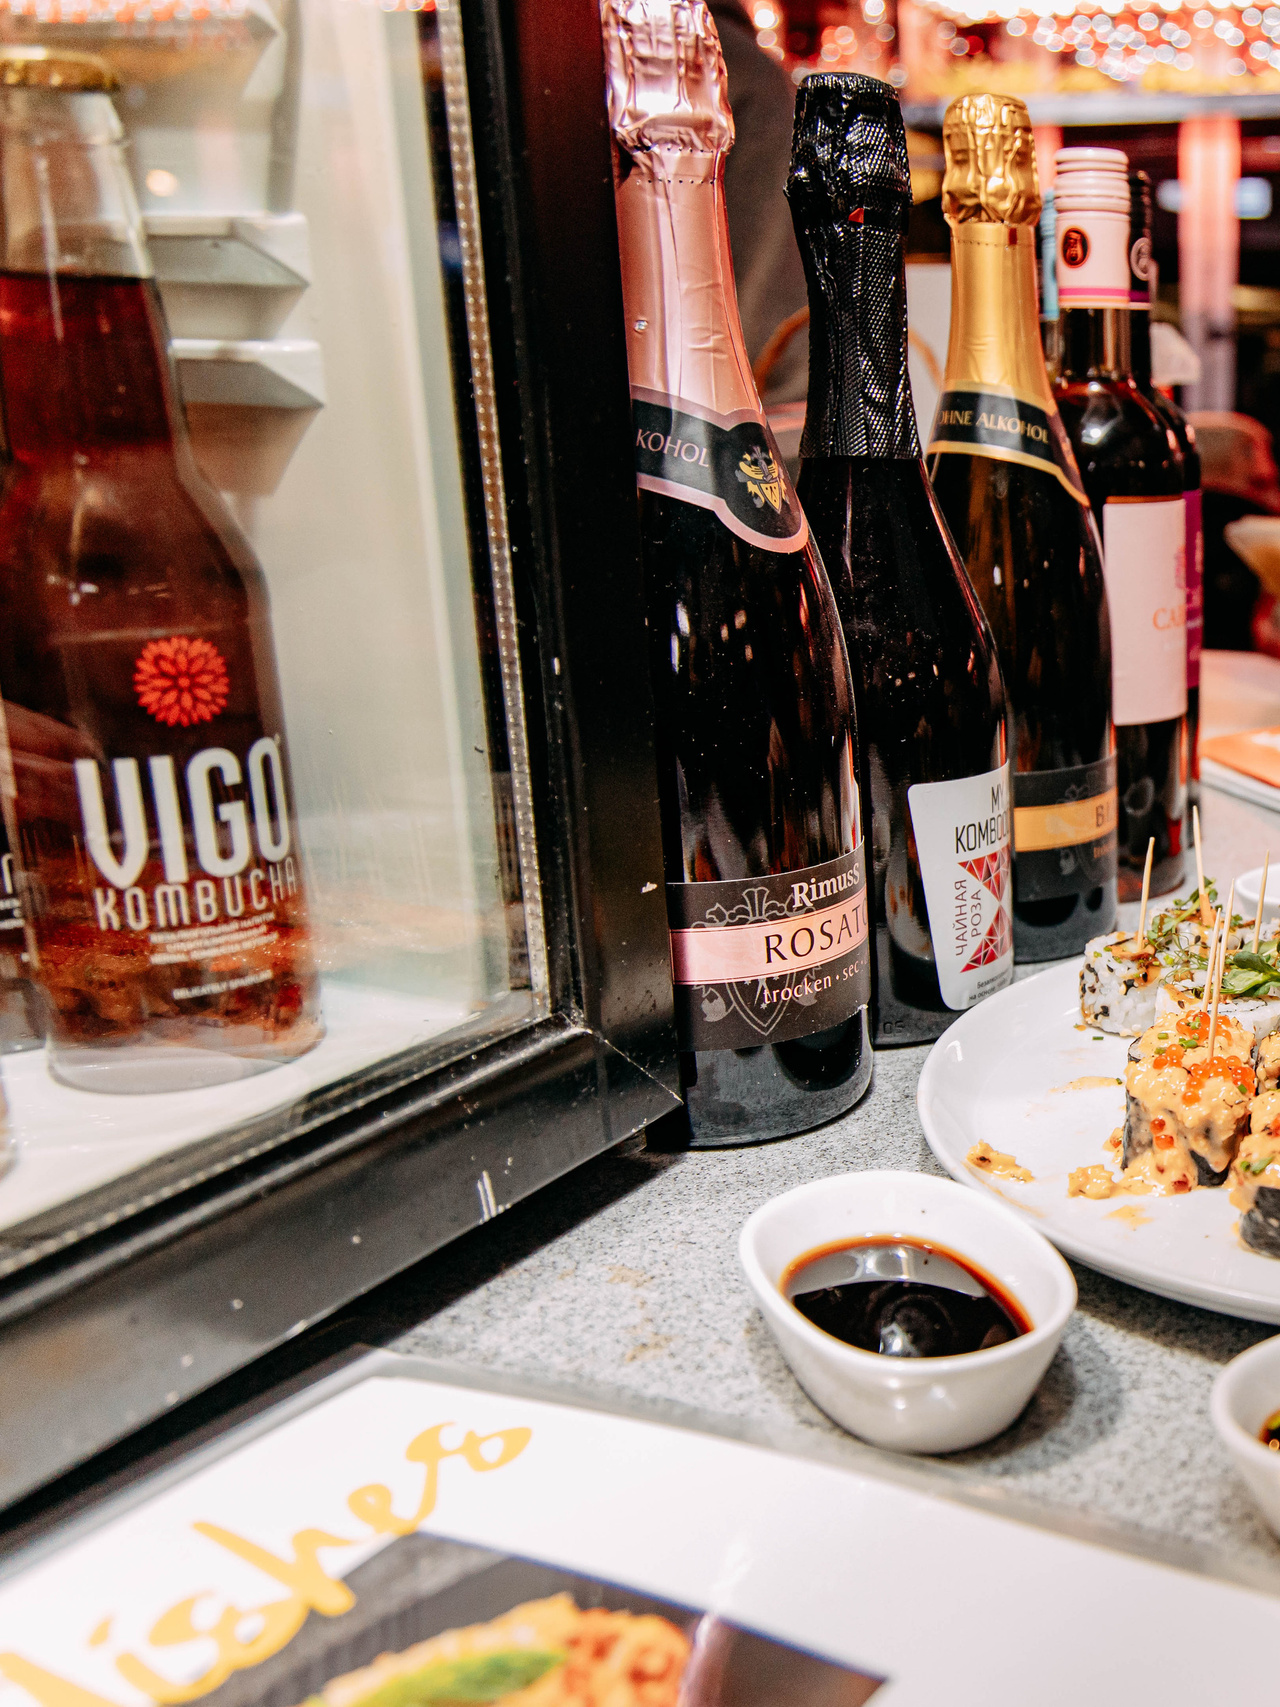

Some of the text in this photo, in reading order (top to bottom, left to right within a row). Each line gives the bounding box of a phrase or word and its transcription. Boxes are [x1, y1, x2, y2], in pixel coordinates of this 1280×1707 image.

[635, 429, 710, 468] KOHOL
[976, 412, 1049, 444] ALKOHOL
[74, 737, 290, 889] VIGO
[94, 857, 297, 931] KOMBUCHA
[952, 879, 968, 956] ЧАЙНАЯ
[970, 888, 982, 938] РОЗА
[763, 960, 860, 1005] trocken sec
